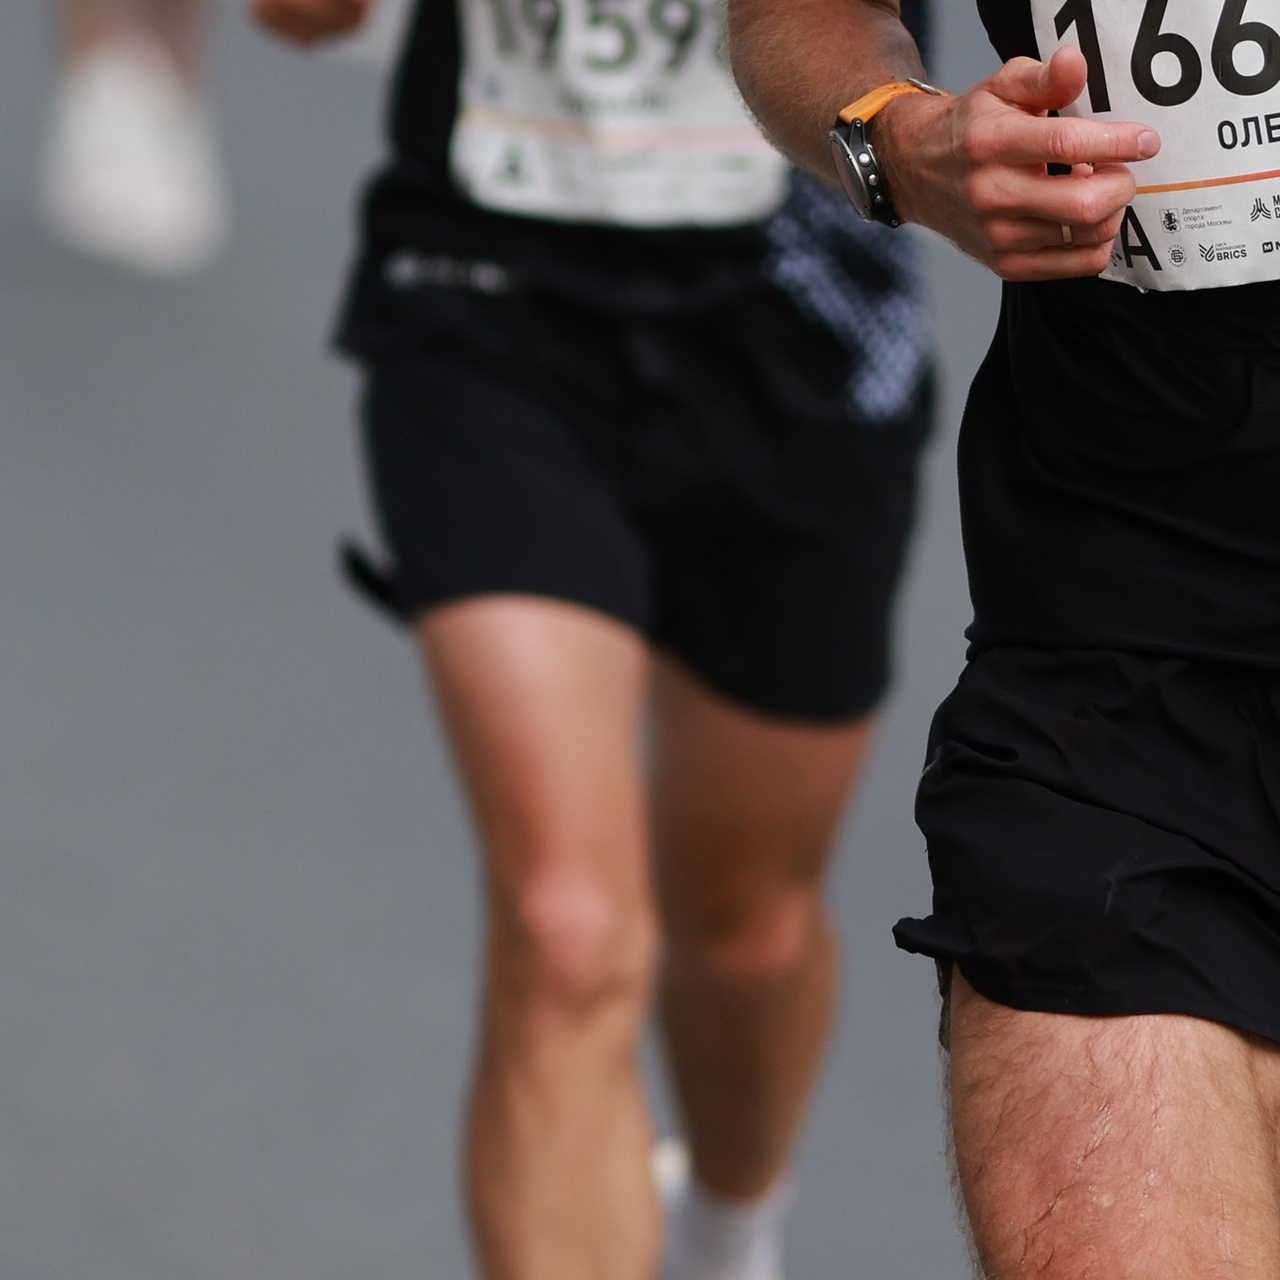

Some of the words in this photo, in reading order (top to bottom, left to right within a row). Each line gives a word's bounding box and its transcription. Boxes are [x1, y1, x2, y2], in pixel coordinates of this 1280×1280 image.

[1182, 204, 1223, 215] Департамент
[1183, 214, 1205, 222] спорта
[1184, 222, 1206, 230] города
[1206, 219, 1232, 227] Москвы
[1216, 249, 1247, 261] BRICS
